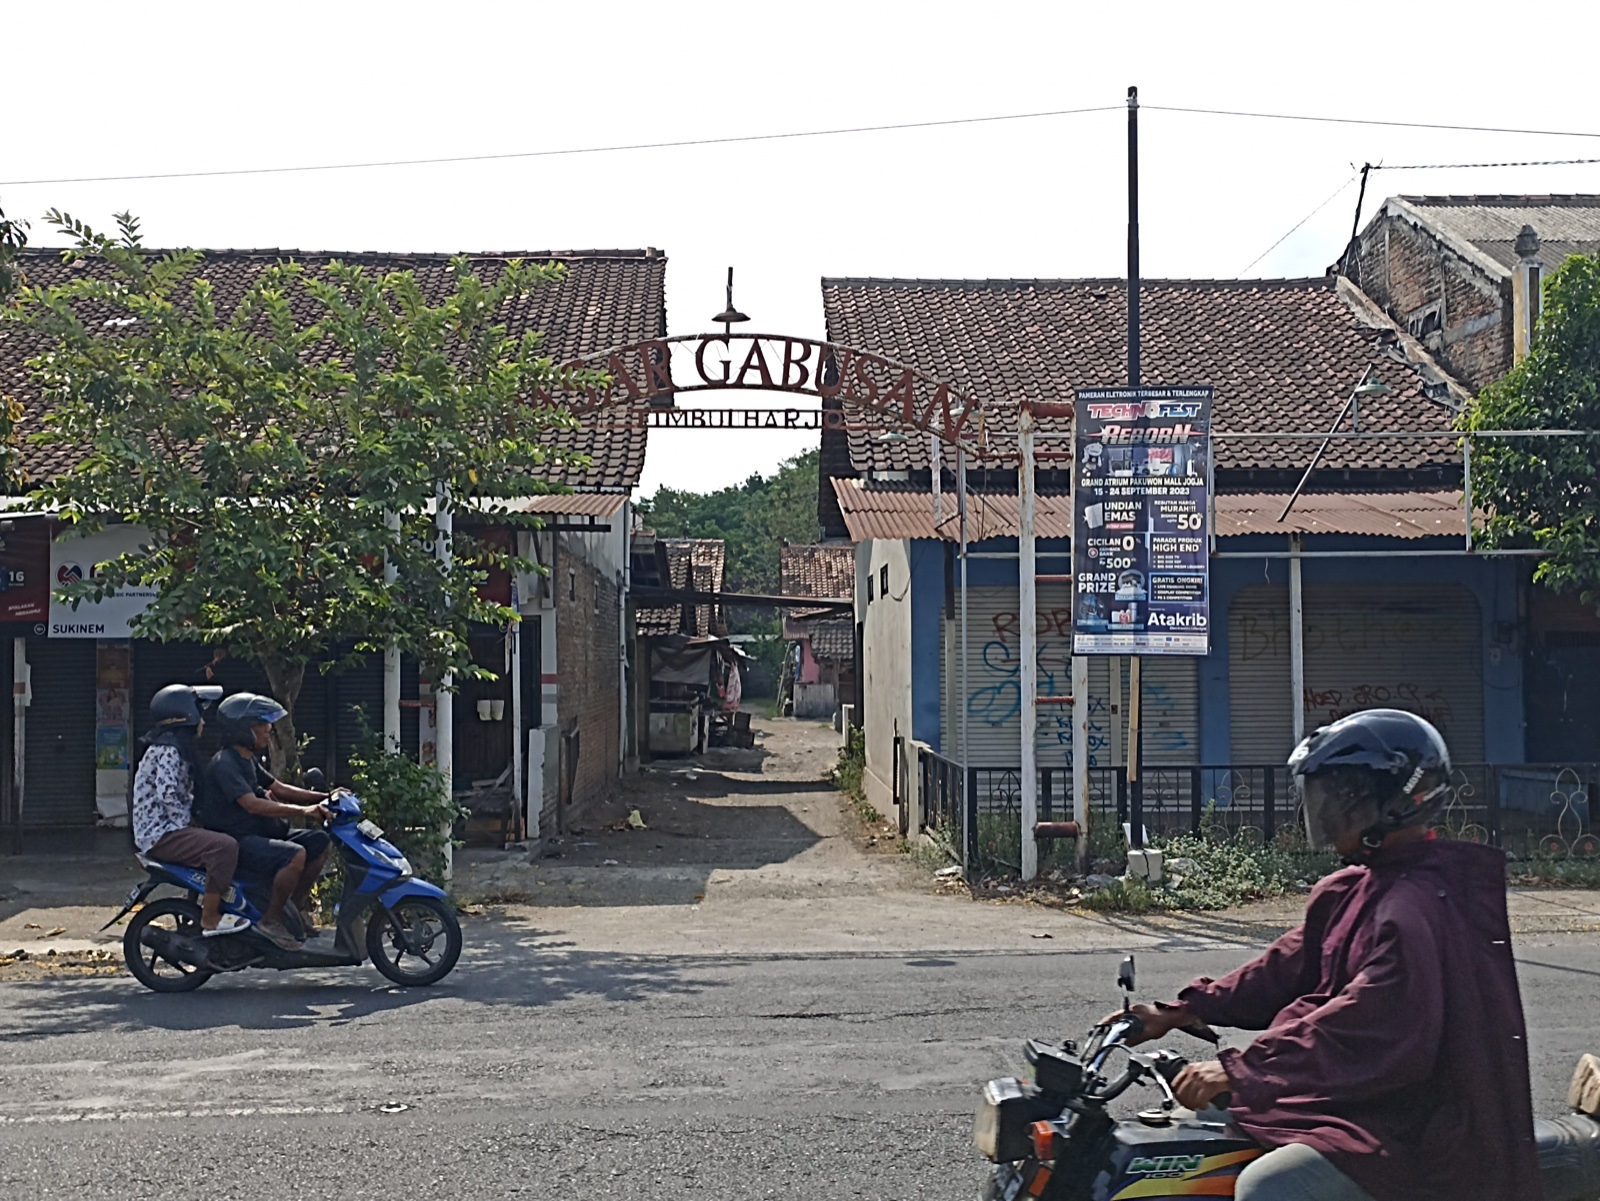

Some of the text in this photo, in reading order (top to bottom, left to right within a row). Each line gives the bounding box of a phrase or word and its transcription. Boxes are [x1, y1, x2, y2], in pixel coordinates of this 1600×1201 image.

[695, 337, 978, 441] GABUSAN
[1172, 390, 1209, 398] TERLENGKAP
[1087, 400, 1202, 420] TECHNOFEST
[1101, 424, 1192, 445] REBORN
[1081, 479, 1103, 487] GRAND
[1130, 478, 1162, 486] PAKUWON
[1164, 478, 1181, 486] MALL
[1183, 478, 1204, 486] JOGJA
[1094, 488, 1103, 496] 15
[1121, 487, 1167, 495] SEPTEMBER
[1170, 487, 1190, 495] 2023
[1104, 502, 1142, 510] UNDIAN
[1104, 511, 1136, 521] EMAS
[1087, 538, 1121, 546] CICILAN
[1152, 543, 1199, 552] HIGH END
[8, 571, 25, 582] 16
[1078, 573, 1116, 582] GRAND
[1078, 582, 1116, 593] PRIZE
[1147, 612, 1207, 626] Atakrib
[53, 624, 105, 634] SUKINEM
[1125, 1154, 1205, 1174] WIN
